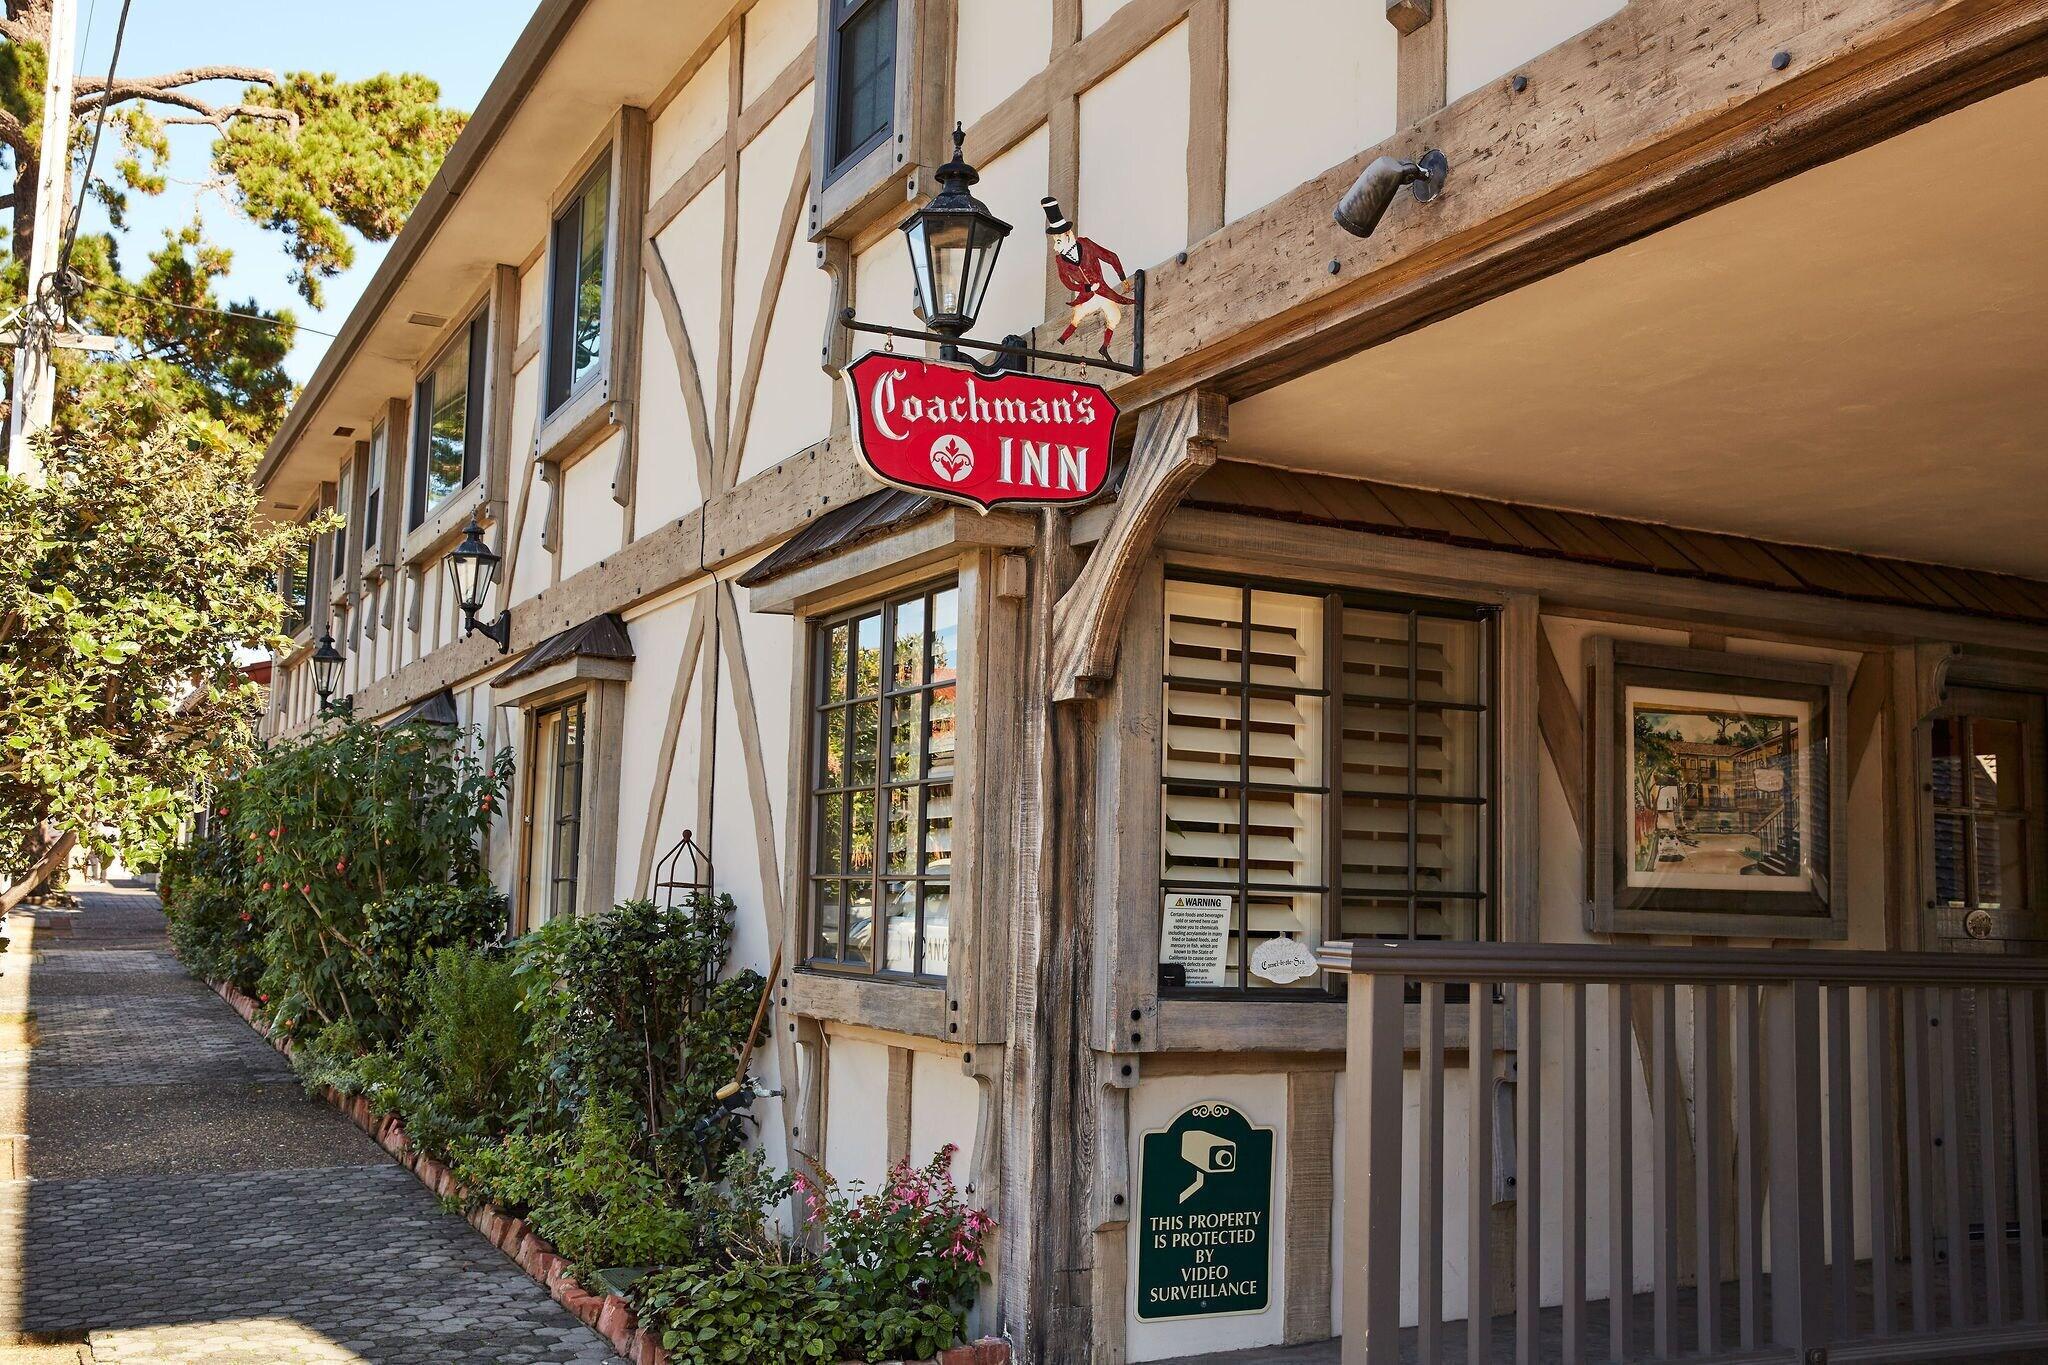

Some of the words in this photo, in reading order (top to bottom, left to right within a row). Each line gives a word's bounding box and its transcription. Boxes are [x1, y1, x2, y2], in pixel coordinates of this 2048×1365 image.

[871, 368, 1096, 441] Coachman's
[997, 436, 1090, 492] INN
[1185, 898, 1222, 907] WARNING
[1150, 1215, 1183, 1231] THIS
[1189, 1211, 1261, 1229] PROPERTY
[1154, 1234, 1167, 1248] IS
[1172, 1229, 1255, 1248] PROTECTED
[1195, 1249, 1215, 1263] BY
[1181, 1265, 1229, 1282] VIDEO
[1150, 1280, 1257, 1303] SURVEILLANCE
